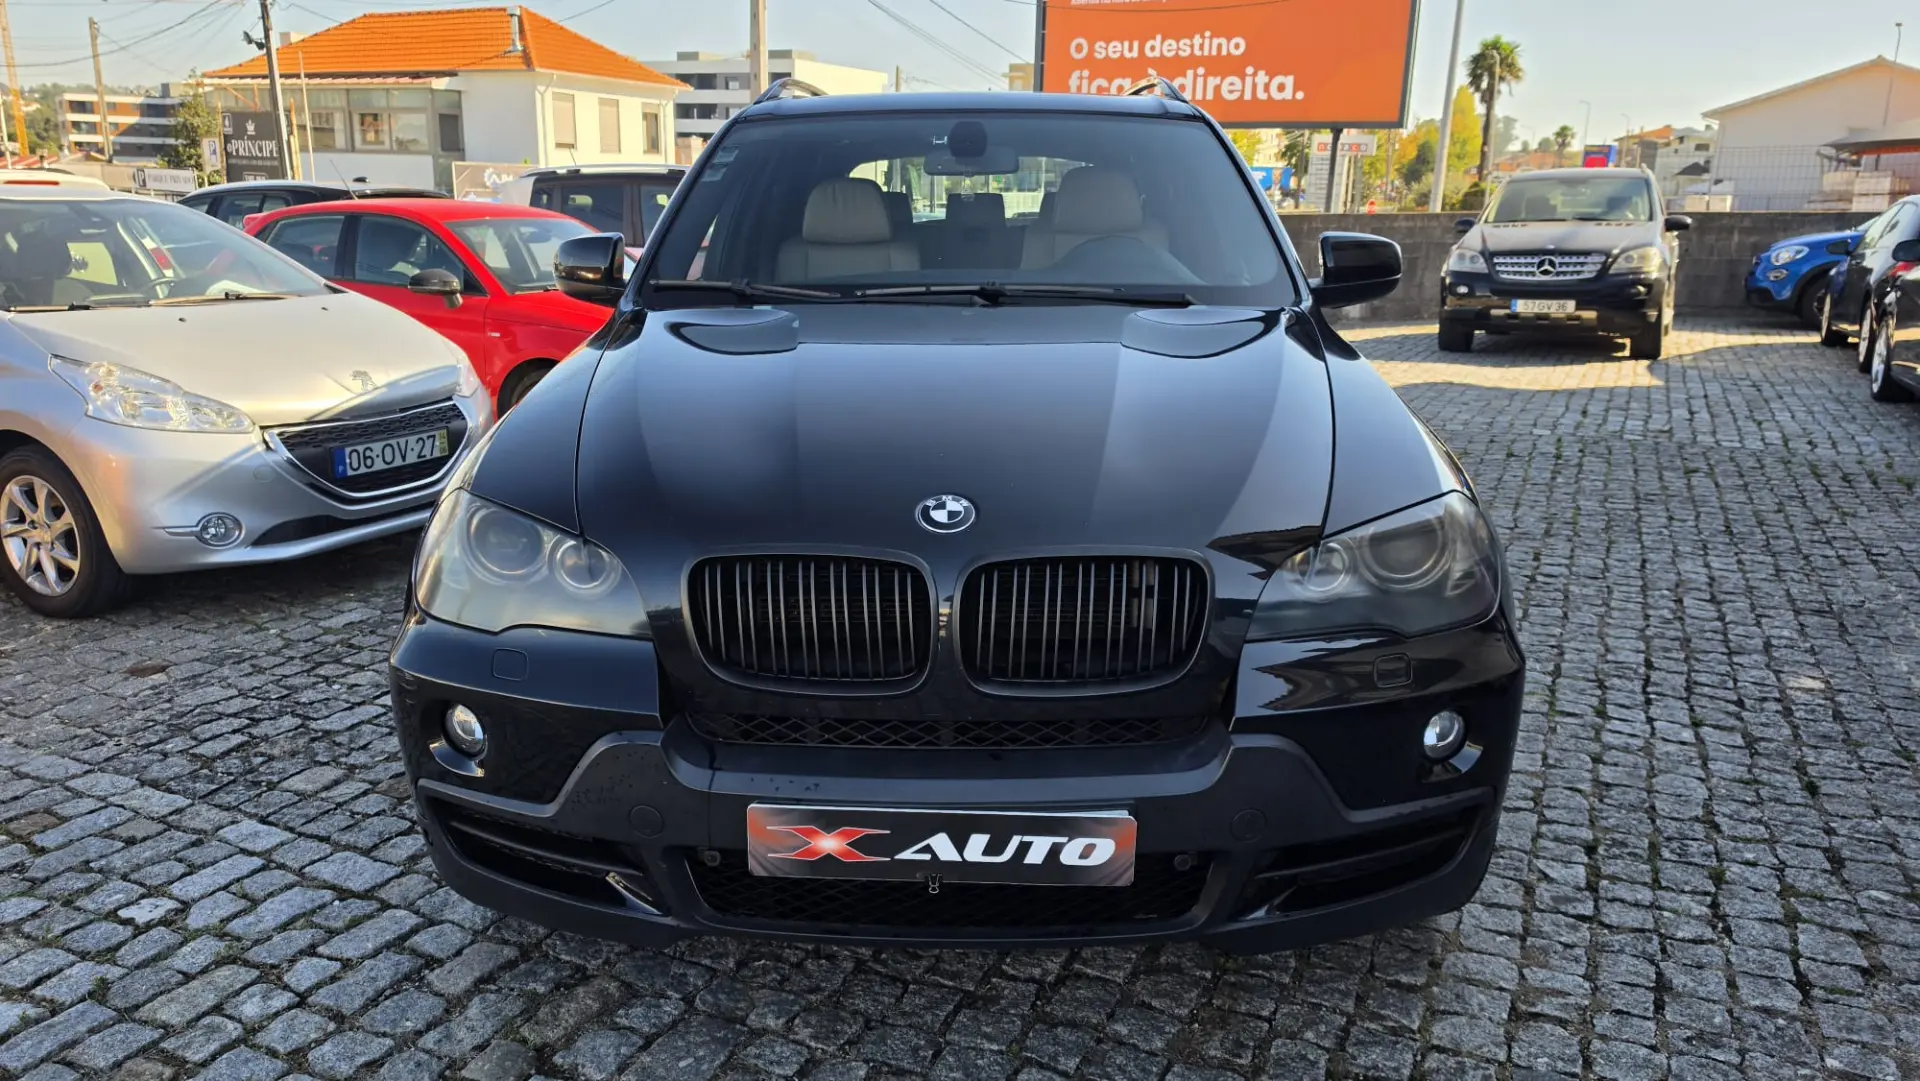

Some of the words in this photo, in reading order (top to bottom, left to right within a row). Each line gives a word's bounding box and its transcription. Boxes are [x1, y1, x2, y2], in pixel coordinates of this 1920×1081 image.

[1069, 37, 1088, 60] O
[1094, 40, 1139, 59] seu
[1144, 31, 1246, 58] destino
[1172, 66, 1304, 101] direita.
[926, 495, 970, 506] BMW
[894, 832, 1116, 866] AUTO
